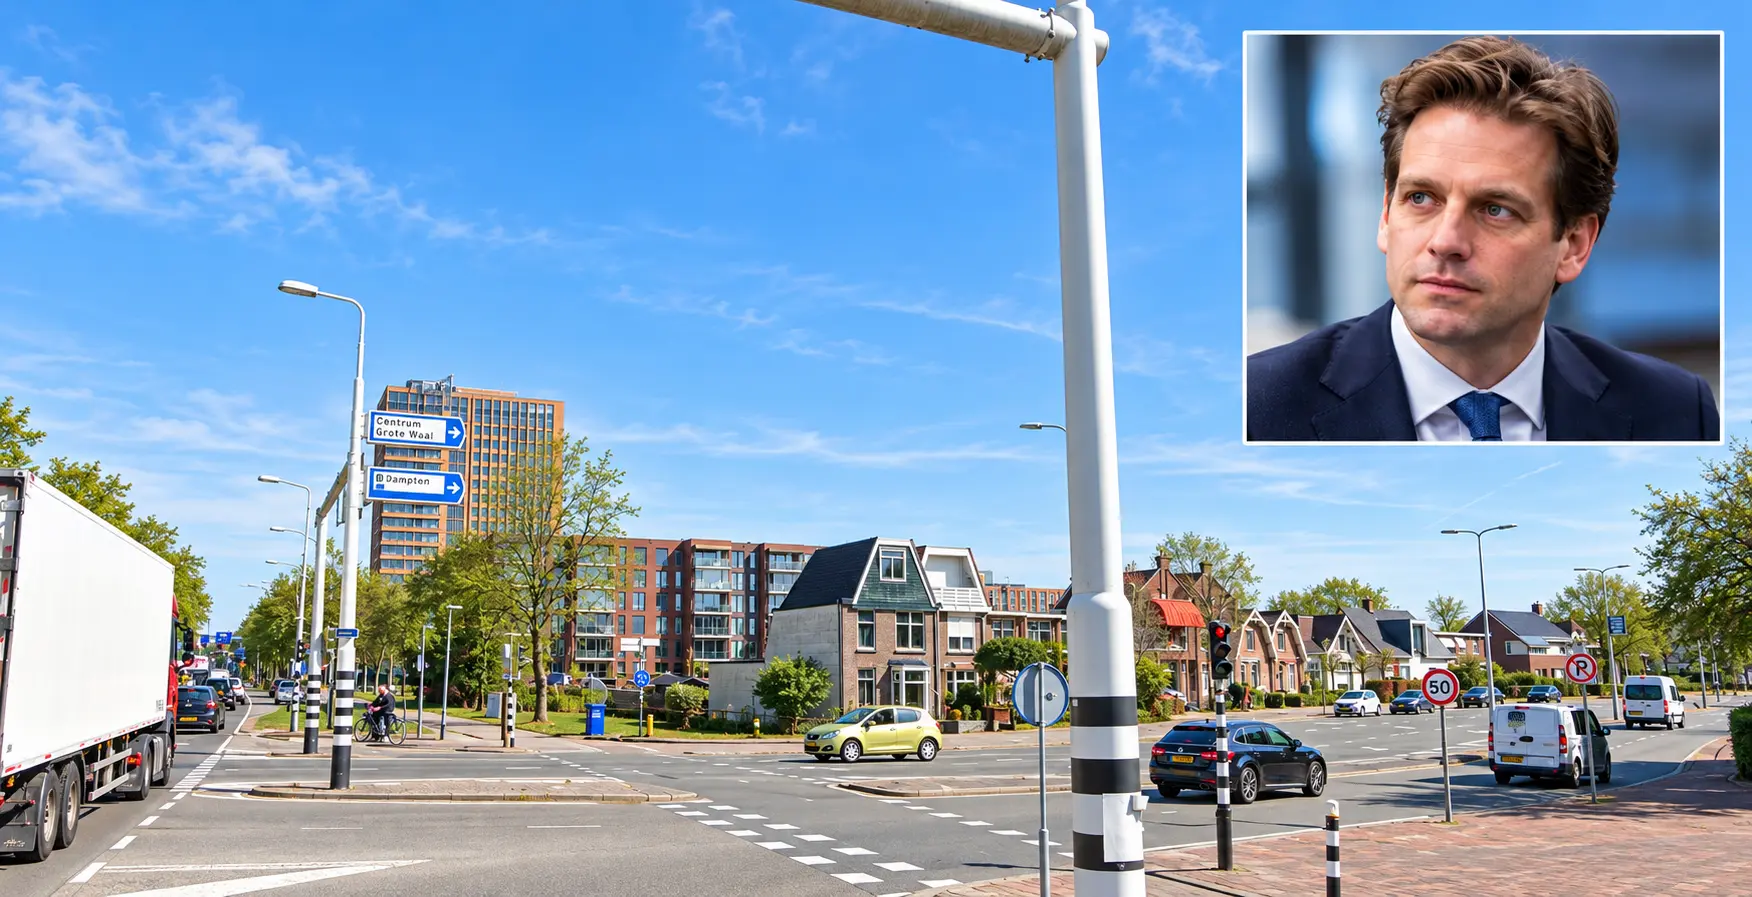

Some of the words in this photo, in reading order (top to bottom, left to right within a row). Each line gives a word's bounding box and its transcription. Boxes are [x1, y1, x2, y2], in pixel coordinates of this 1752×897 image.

[376, 417, 421, 428] Centrum
[376, 428, 405, 438] Grote
[386, 474, 430, 486] Dampten
[1429, 680, 1450, 695] 50
